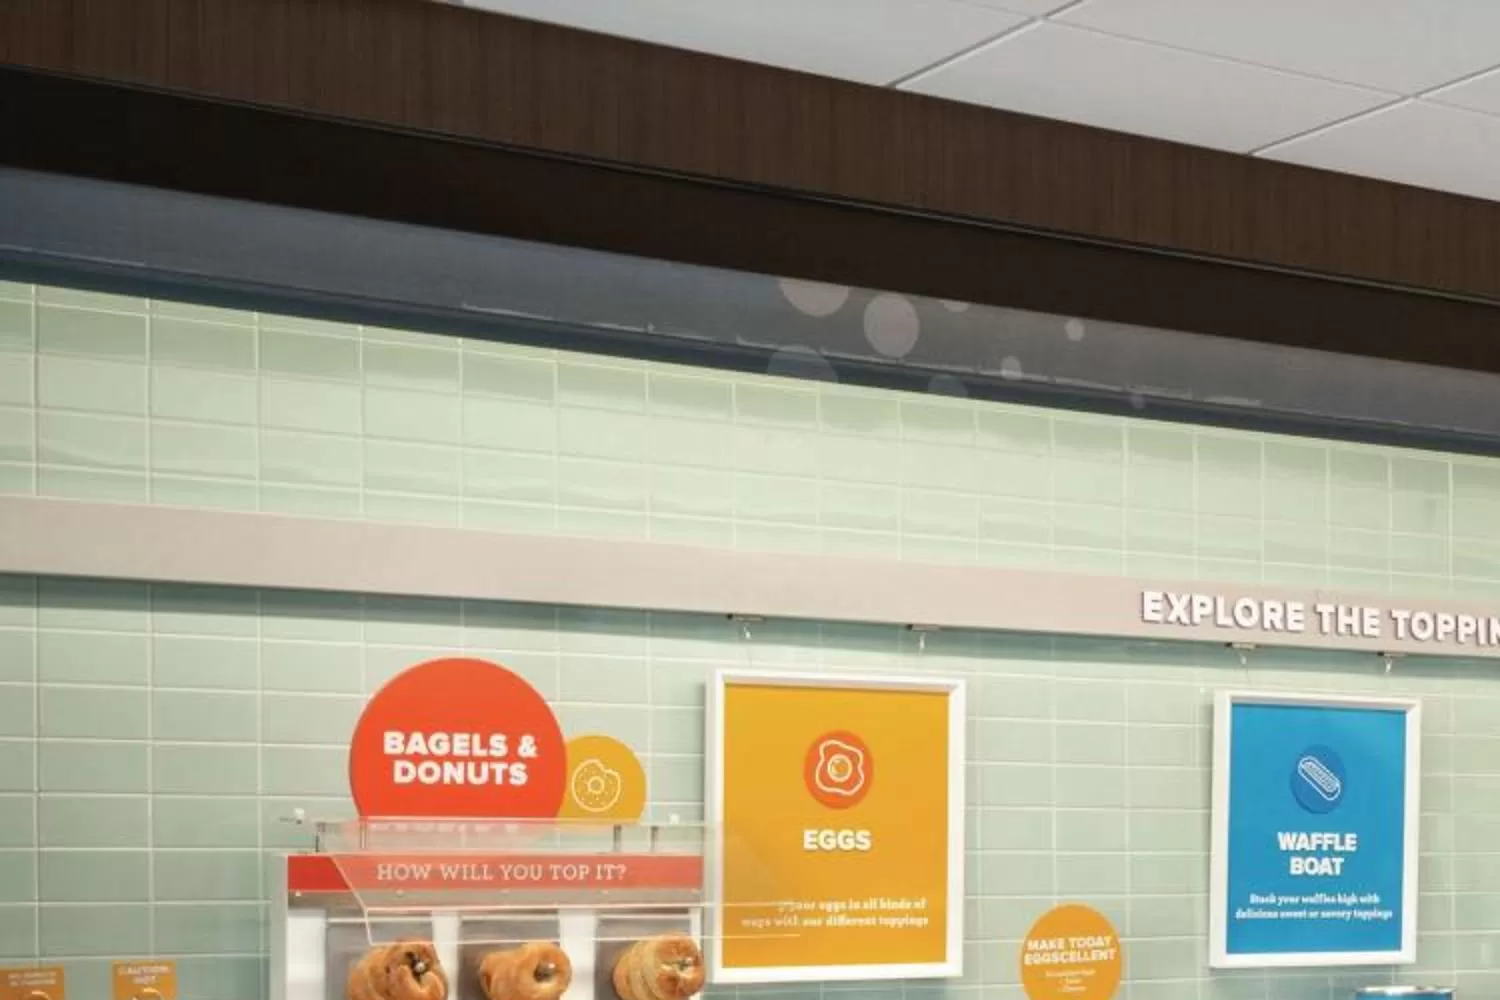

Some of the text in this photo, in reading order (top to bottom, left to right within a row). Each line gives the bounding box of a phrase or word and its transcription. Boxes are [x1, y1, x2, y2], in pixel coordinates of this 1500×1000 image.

[1141, 590, 1305, 632] EXPLORE
[1316, 602, 1381, 638] THE
[383, 730, 538, 757] BAGELS &
[393, 759, 528, 786] DONUTS
[802, 828, 872, 851] EGGS
[1277, 831, 1358, 852] WAFFLE
[376, 863, 626, 881] HOW WILL YOU TOP IT?
[1289, 856, 1345, 876] BOAT
[825, 914, 876, 927] different
[879, 914, 928, 929] toppings
[1027, 936, 1112, 950] MAKE TODAY
